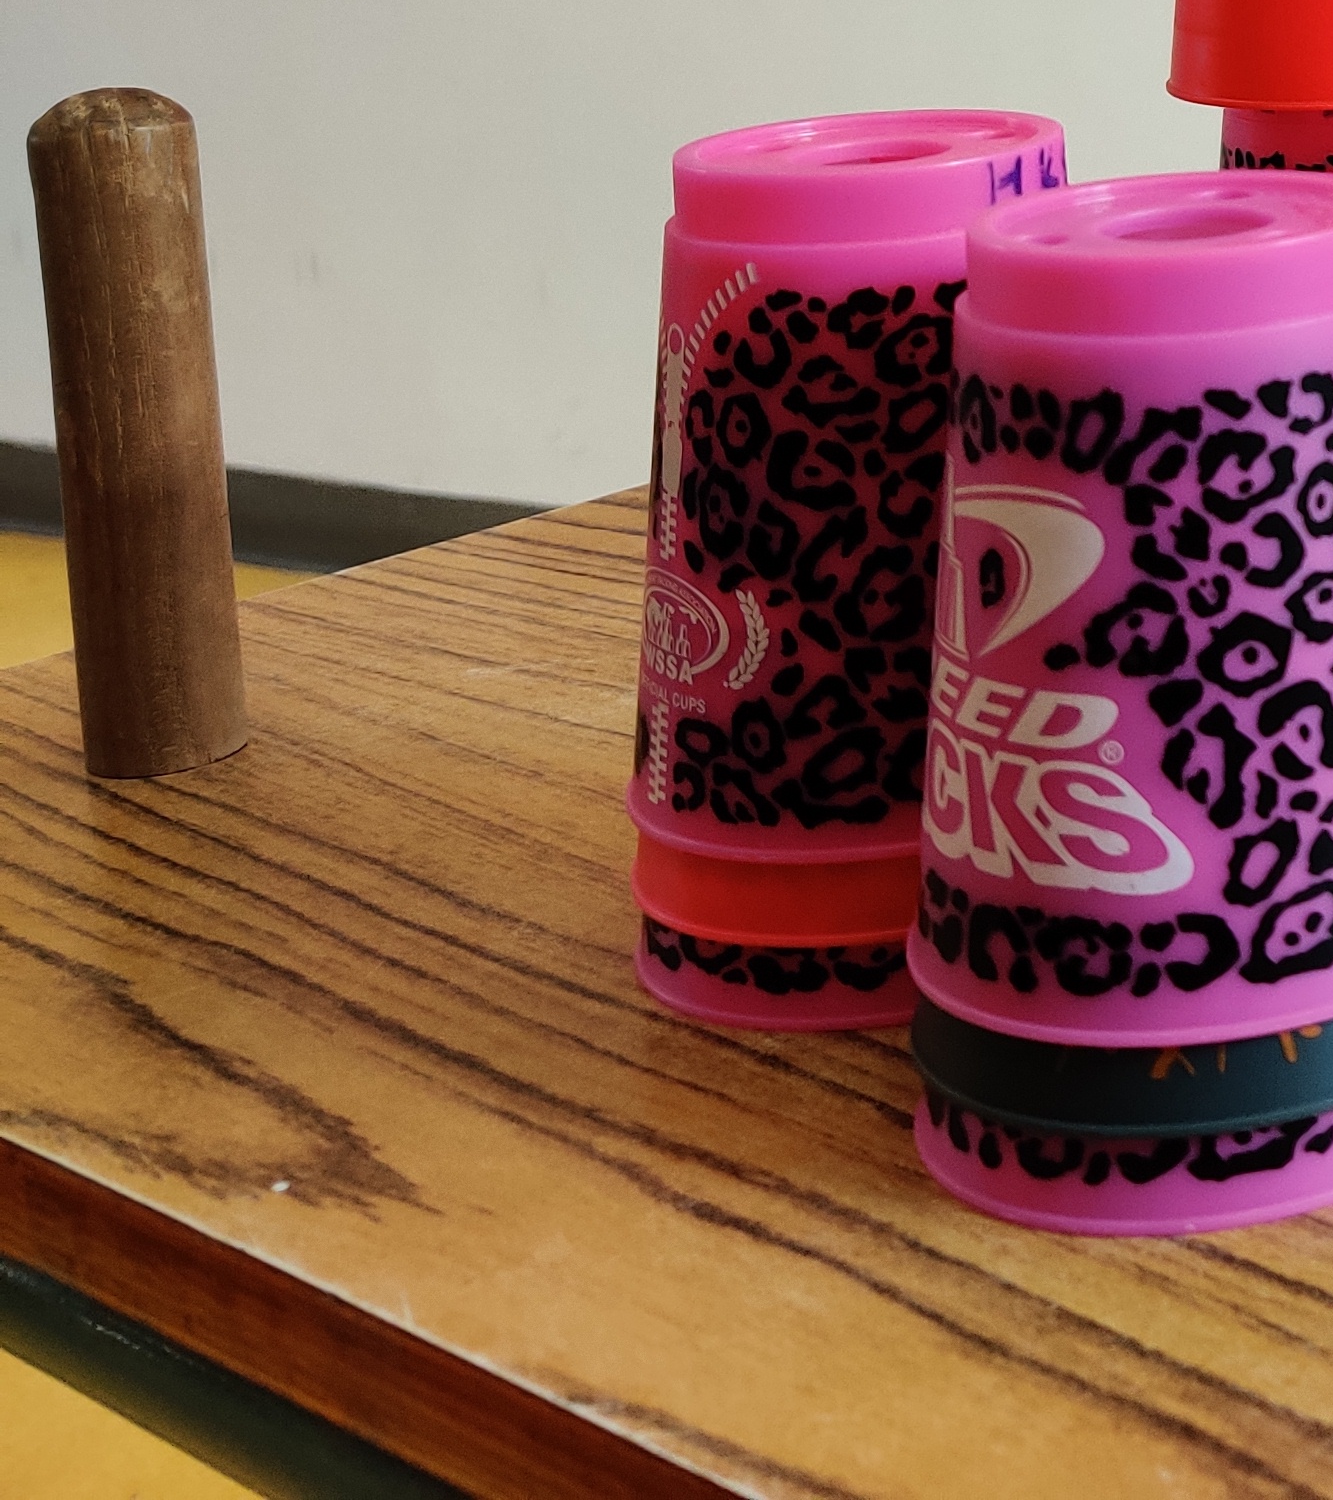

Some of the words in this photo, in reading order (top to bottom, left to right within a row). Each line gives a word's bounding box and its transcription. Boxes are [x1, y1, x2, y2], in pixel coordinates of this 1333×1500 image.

[671, 691, 707, 715] CUPS
[931, 657, 1119, 749] EED
[922, 718, 1195, 895] CKS
